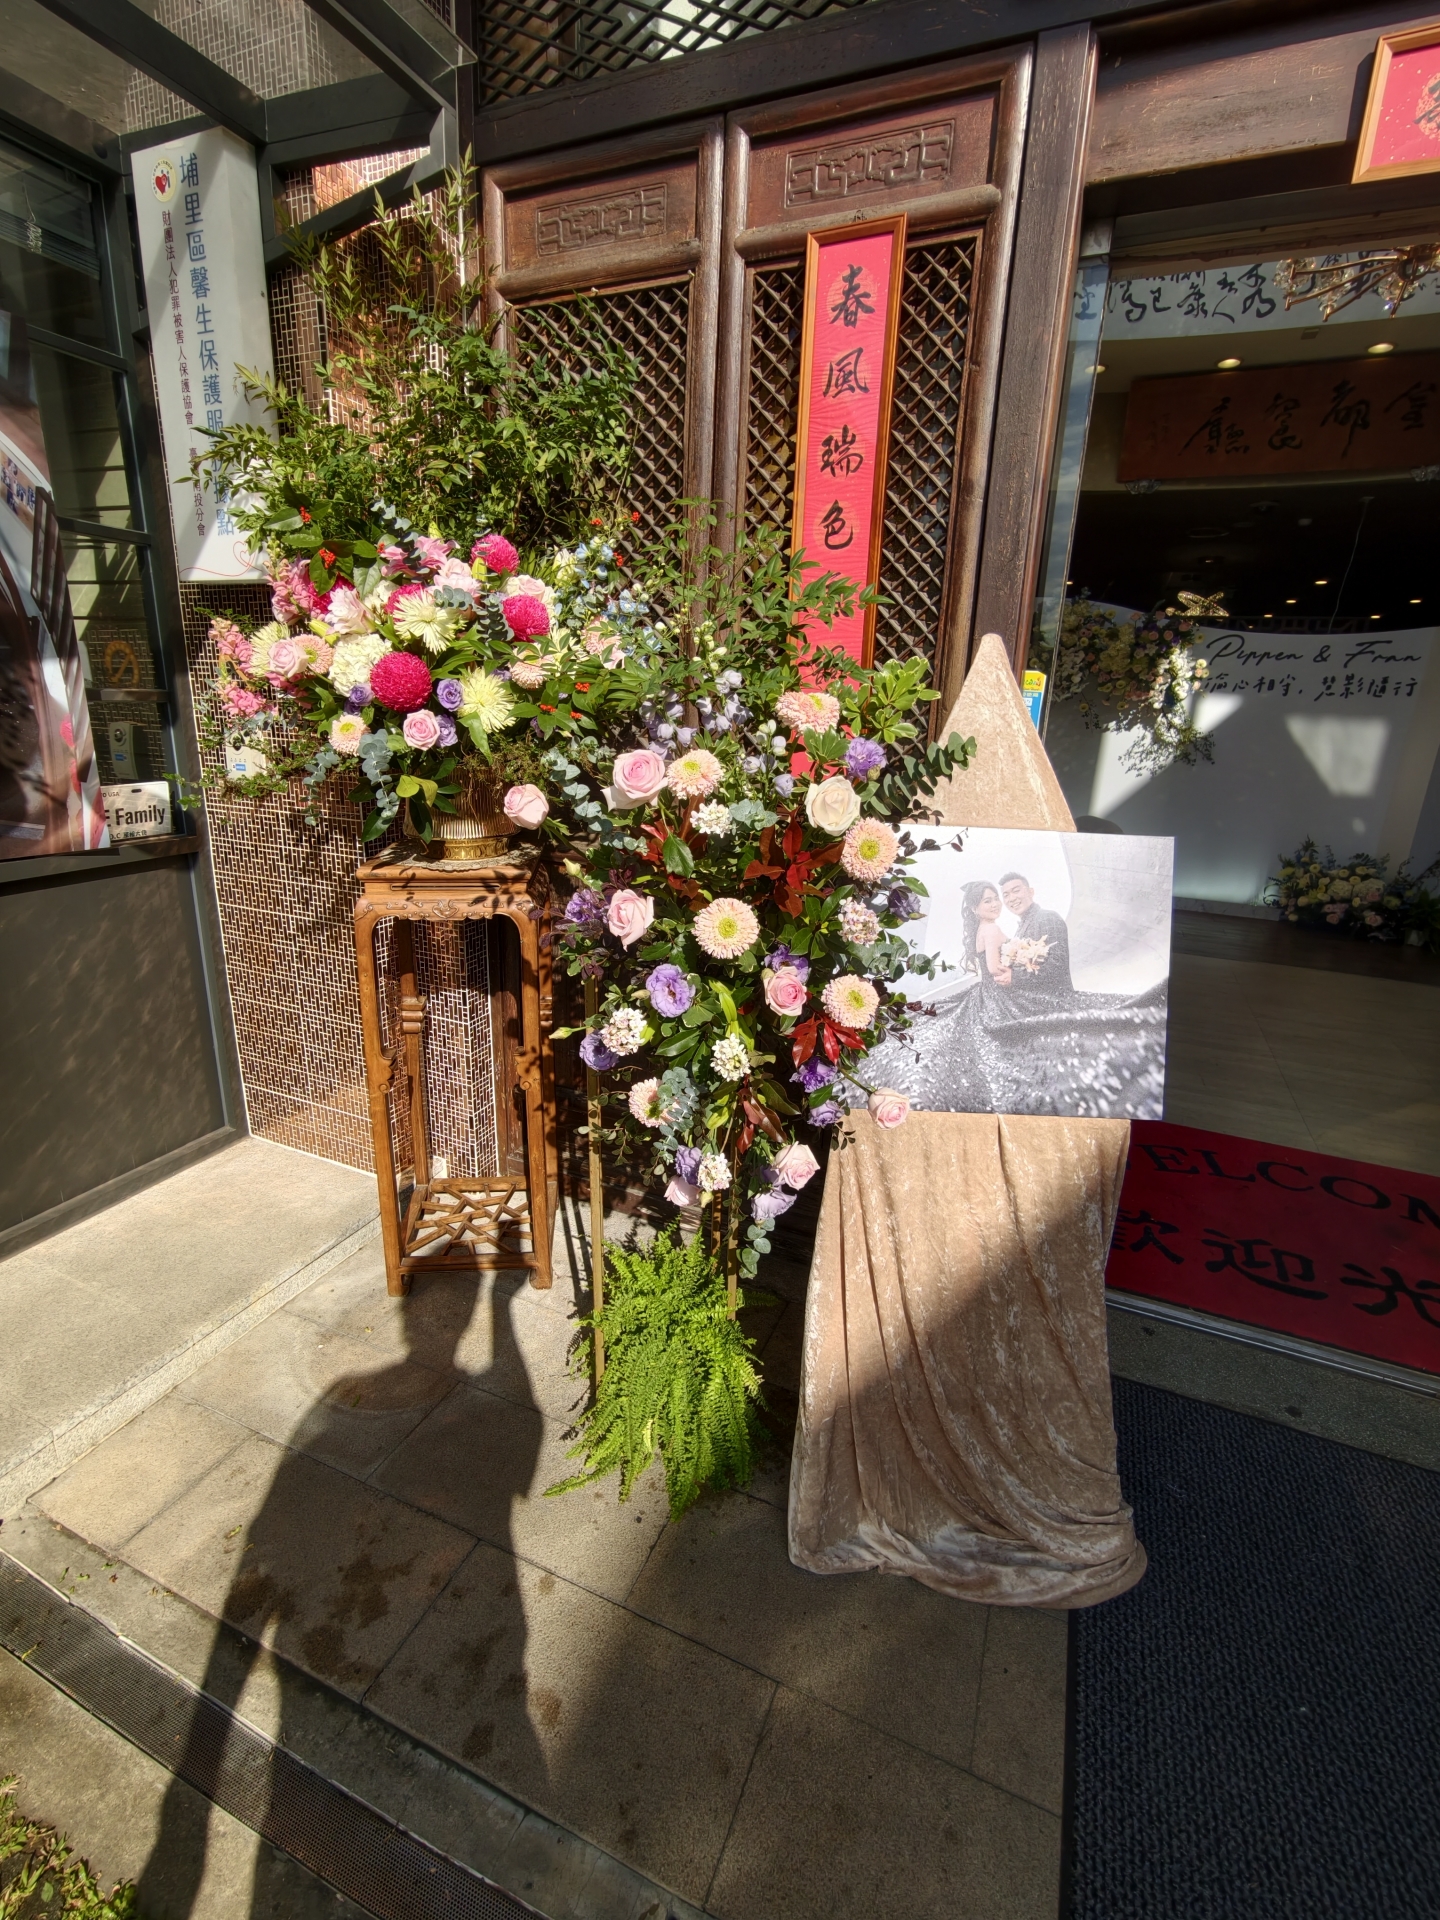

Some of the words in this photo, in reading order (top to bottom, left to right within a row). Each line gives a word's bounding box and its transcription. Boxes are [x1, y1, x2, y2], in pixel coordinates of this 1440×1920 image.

[815, 262, 876, 684] 春風瑞色
[1206, 633, 1304, 667] Pippen
[1313, 644, 1332, 663] &
[1343, 639, 1423, 668] Fran
[115, 804, 166, 826] Family
[1127, 1142, 1440, 1229] ELCO
